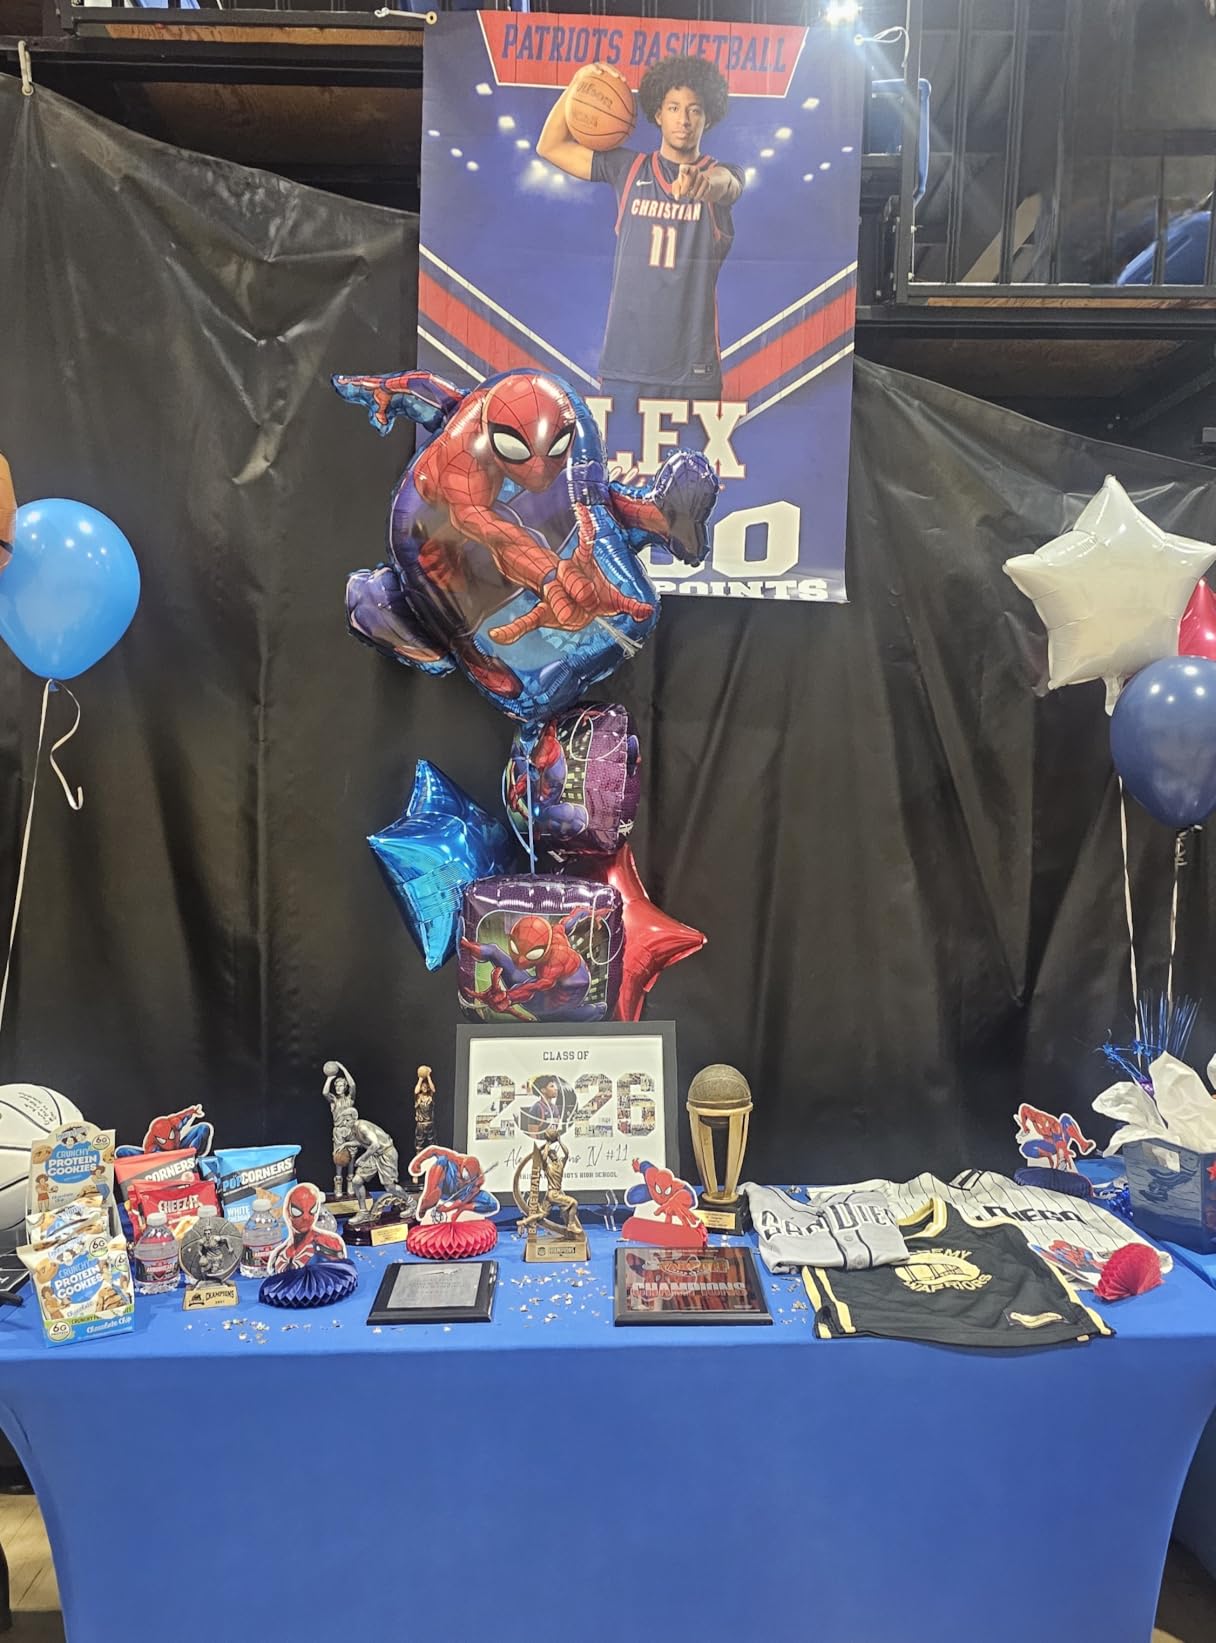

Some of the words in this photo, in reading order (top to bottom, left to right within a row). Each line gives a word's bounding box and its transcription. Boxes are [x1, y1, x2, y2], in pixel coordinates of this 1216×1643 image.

[502, 23, 622, 65] PATRIOTS
[629, 29, 787, 73] BASKETBALL
[631, 199, 701, 221] CHRISTIAN
[649, 224, 676, 269] 11
[585, 397, 748, 479] LEX
[543, 1051, 575, 1061] CLASS
[577, 1051, 590, 1060] OF
[48, 1154, 98, 1168] PROTEIN
[55, 1148, 90, 1159] CRUNCHY
[47, 1163, 97, 1176] COOKIES
[145, 1157, 195, 1183] CORNERS
[227, 1205, 249, 1217] WHITE
[54, 1265, 101, 1291] PROTEIN
[58, 1261, 92, 1279] CRUNCHY
[56, 1273, 104, 1300] COOKIES
[630, 1282, 748, 1299] CHAMPIONS
[53, 1323, 67, 1333] 6G
